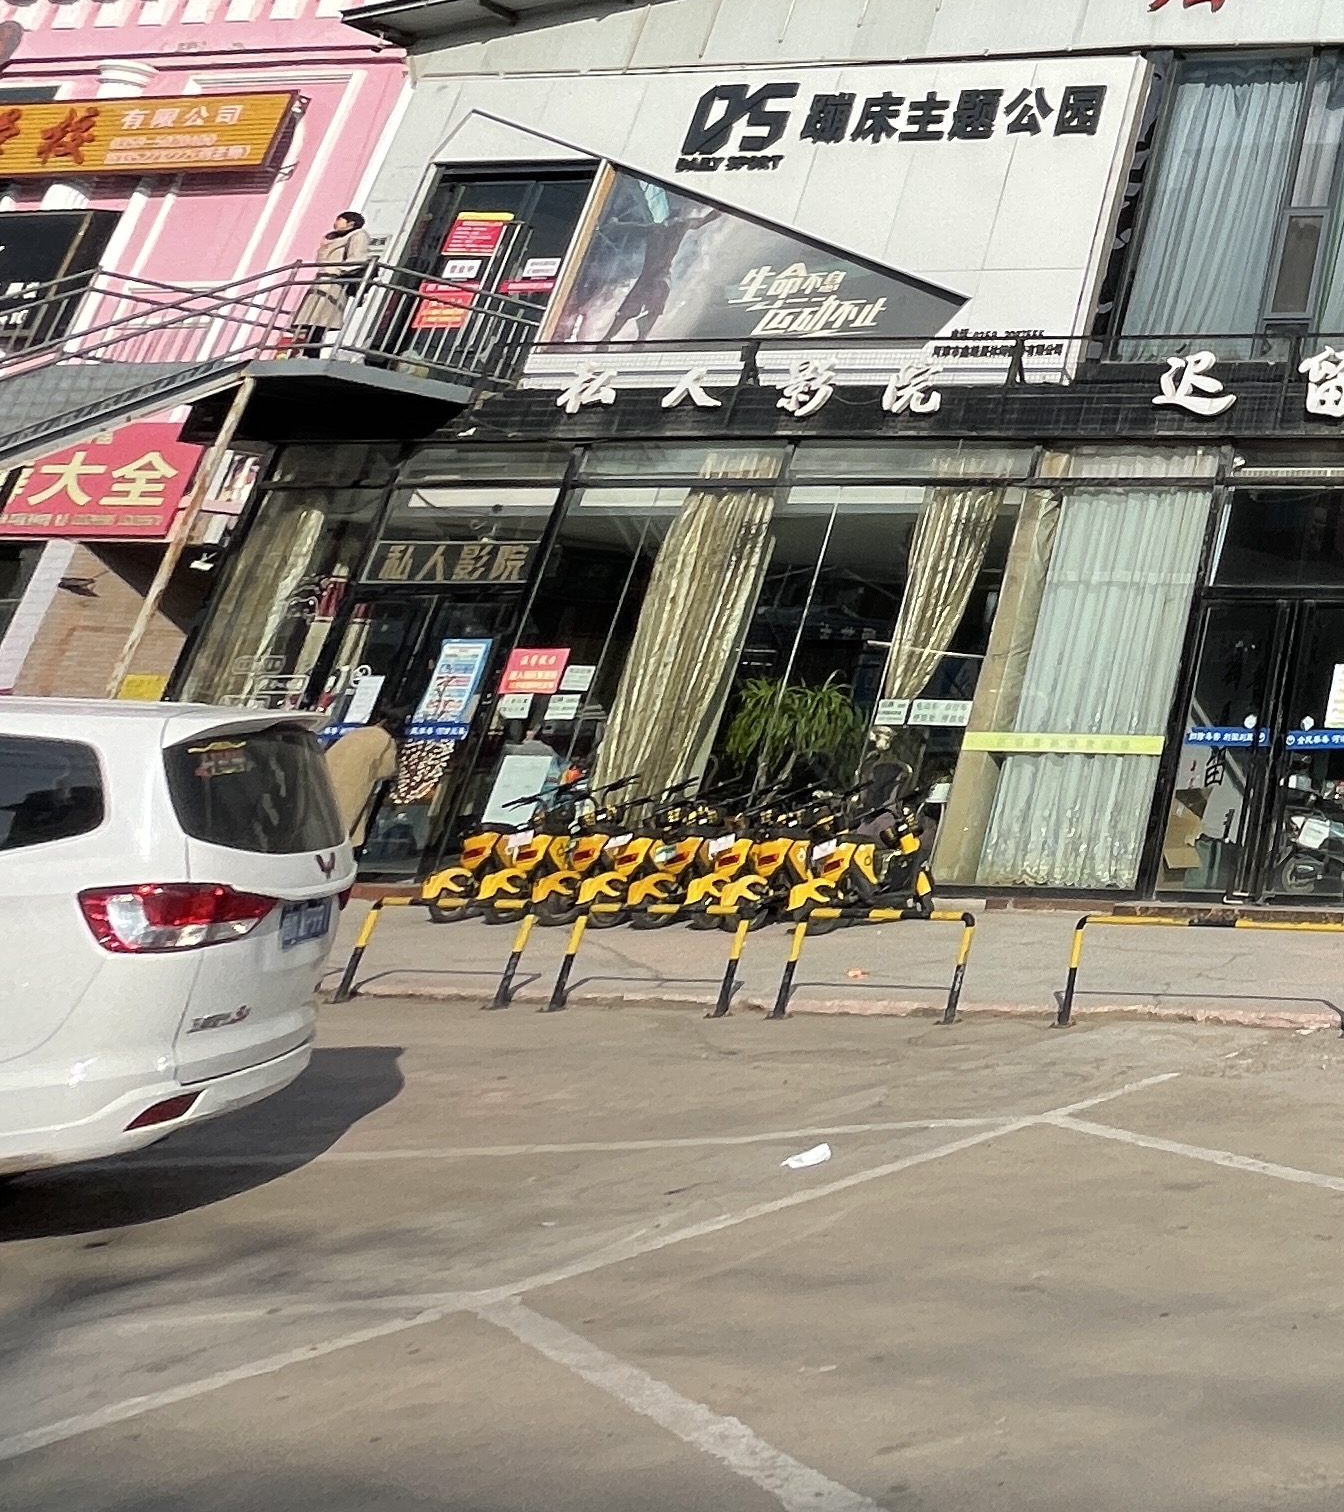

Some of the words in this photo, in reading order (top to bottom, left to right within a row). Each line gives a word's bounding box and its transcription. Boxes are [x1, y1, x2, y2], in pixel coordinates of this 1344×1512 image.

[120, 105, 245, 130] 有限公司
[799, 85, 1108, 144] 蹦床主题公园
[728, 262, 847, 304] 生命不息
[746, 295, 887, 336] 运动不止
[556, 356, 943, 417] 私人影院
[0, 451, 178, 506] 大全
[378, 544, 530, 581] 私人影院
